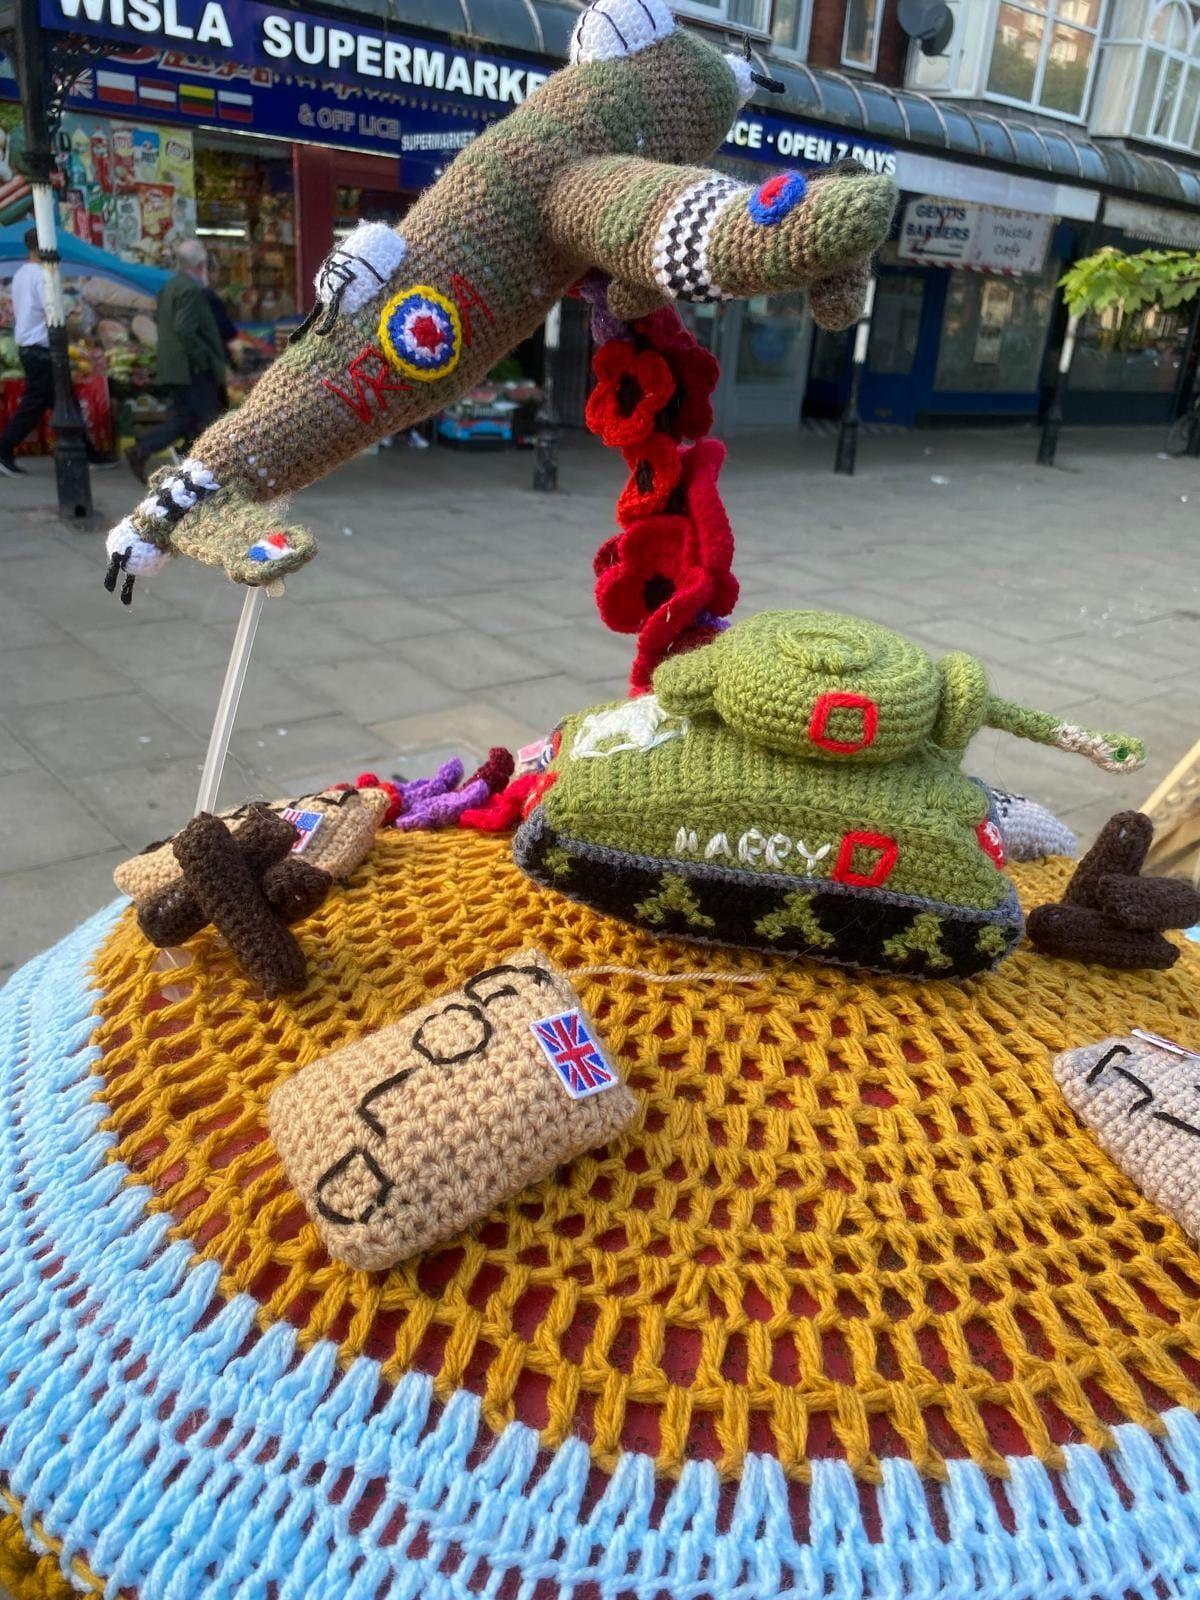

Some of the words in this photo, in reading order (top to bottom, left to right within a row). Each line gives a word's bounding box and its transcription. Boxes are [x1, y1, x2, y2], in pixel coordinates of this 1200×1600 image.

[298, 103, 315, 127] &
[317, 107, 356, 132] OFF
[726, 121, 763, 149] CE
[777, 131, 831, 164] OPEN
[836, 143, 848, 159] 7
[852, 146, 897, 176] DAYS
